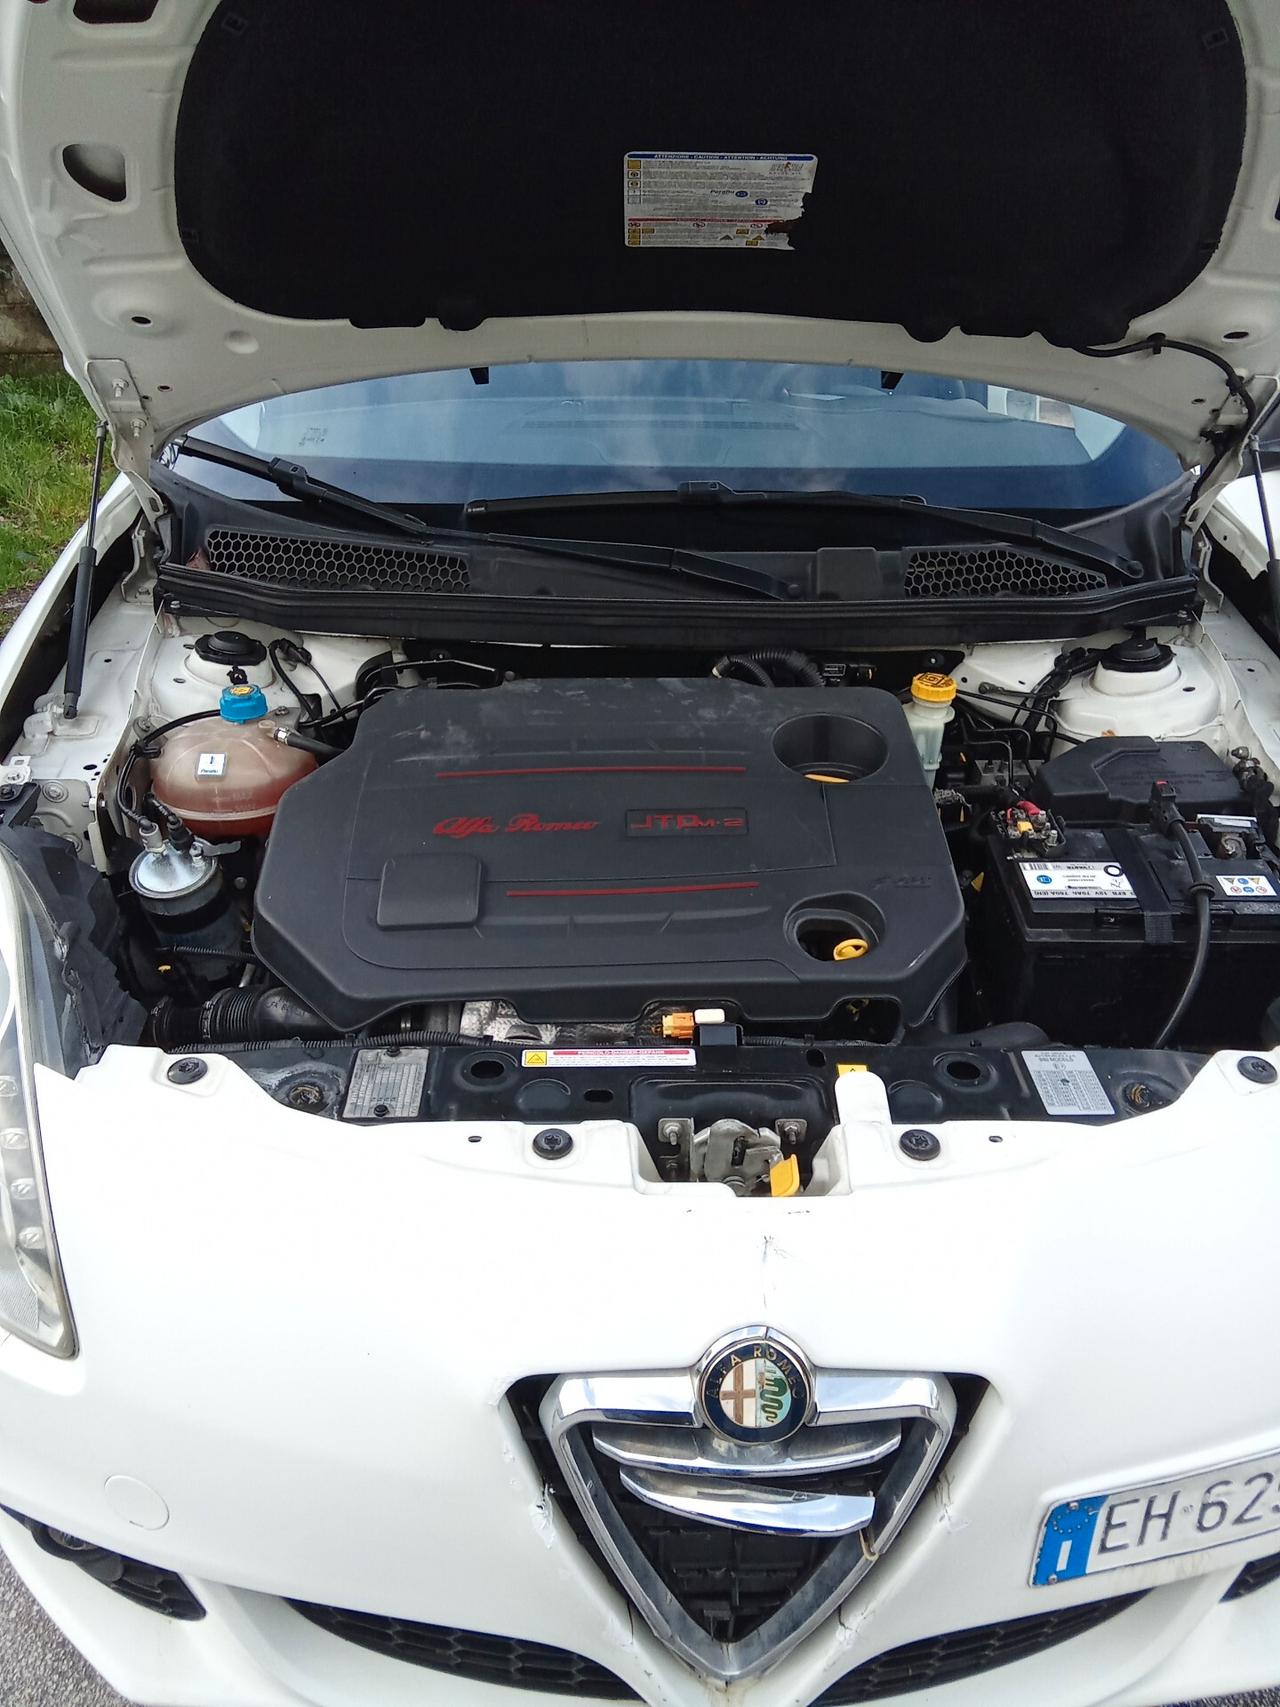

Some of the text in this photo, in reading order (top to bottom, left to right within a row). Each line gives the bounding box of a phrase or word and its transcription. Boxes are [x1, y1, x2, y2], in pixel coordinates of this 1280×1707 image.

[432, 812, 600, 840] Alfa Romeo
[1098, 1490, 1182, 1554] EH
[1196, 1472, 1280, 1533] 62
